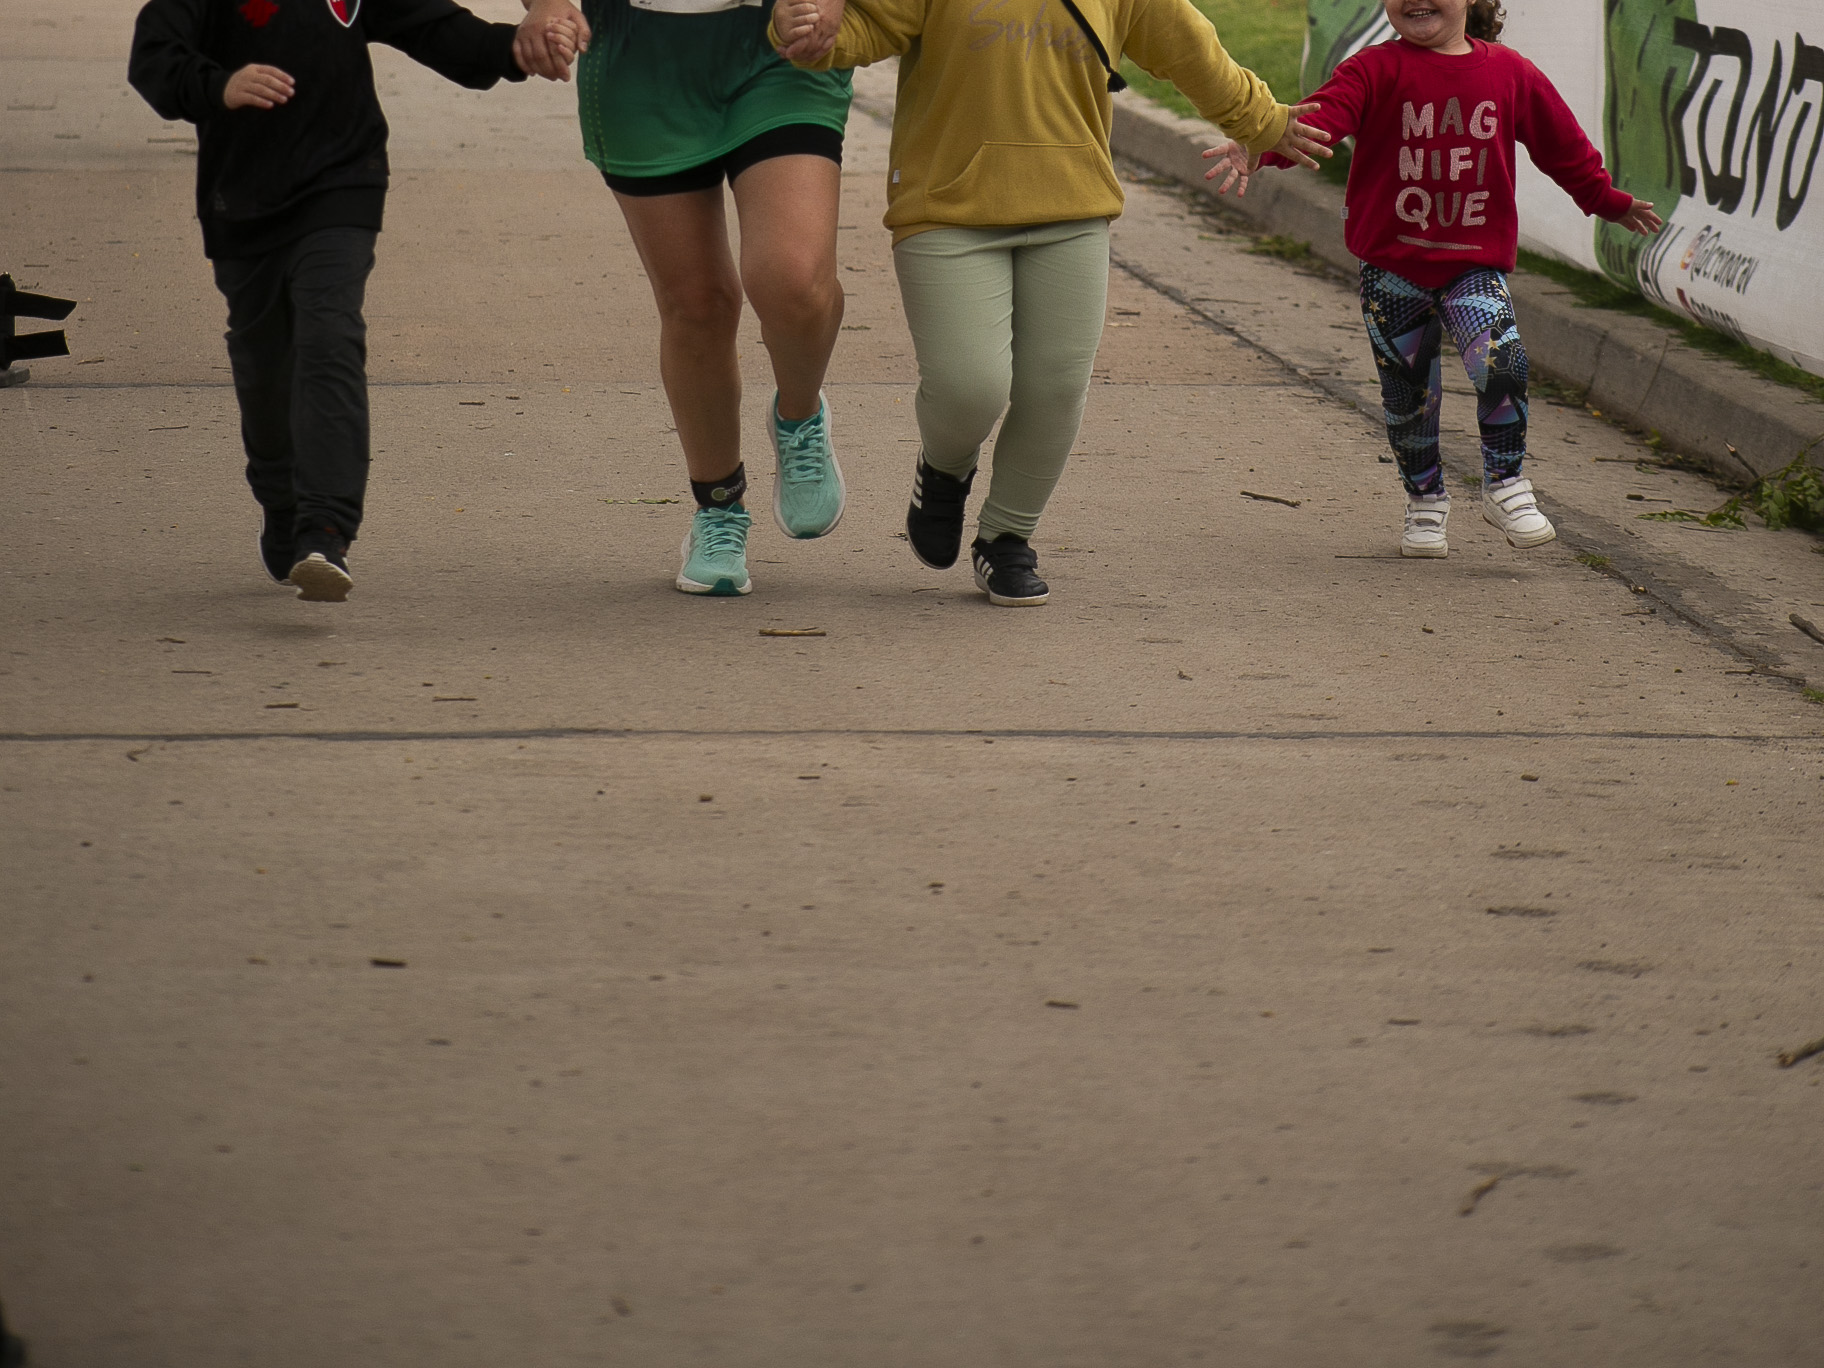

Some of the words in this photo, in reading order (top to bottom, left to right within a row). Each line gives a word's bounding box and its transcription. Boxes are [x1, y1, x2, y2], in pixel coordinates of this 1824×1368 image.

[1402, 96, 1498, 141] MAG
[1398, 145, 1488, 186] NIFI
[1395, 186, 1490, 232] QUE
